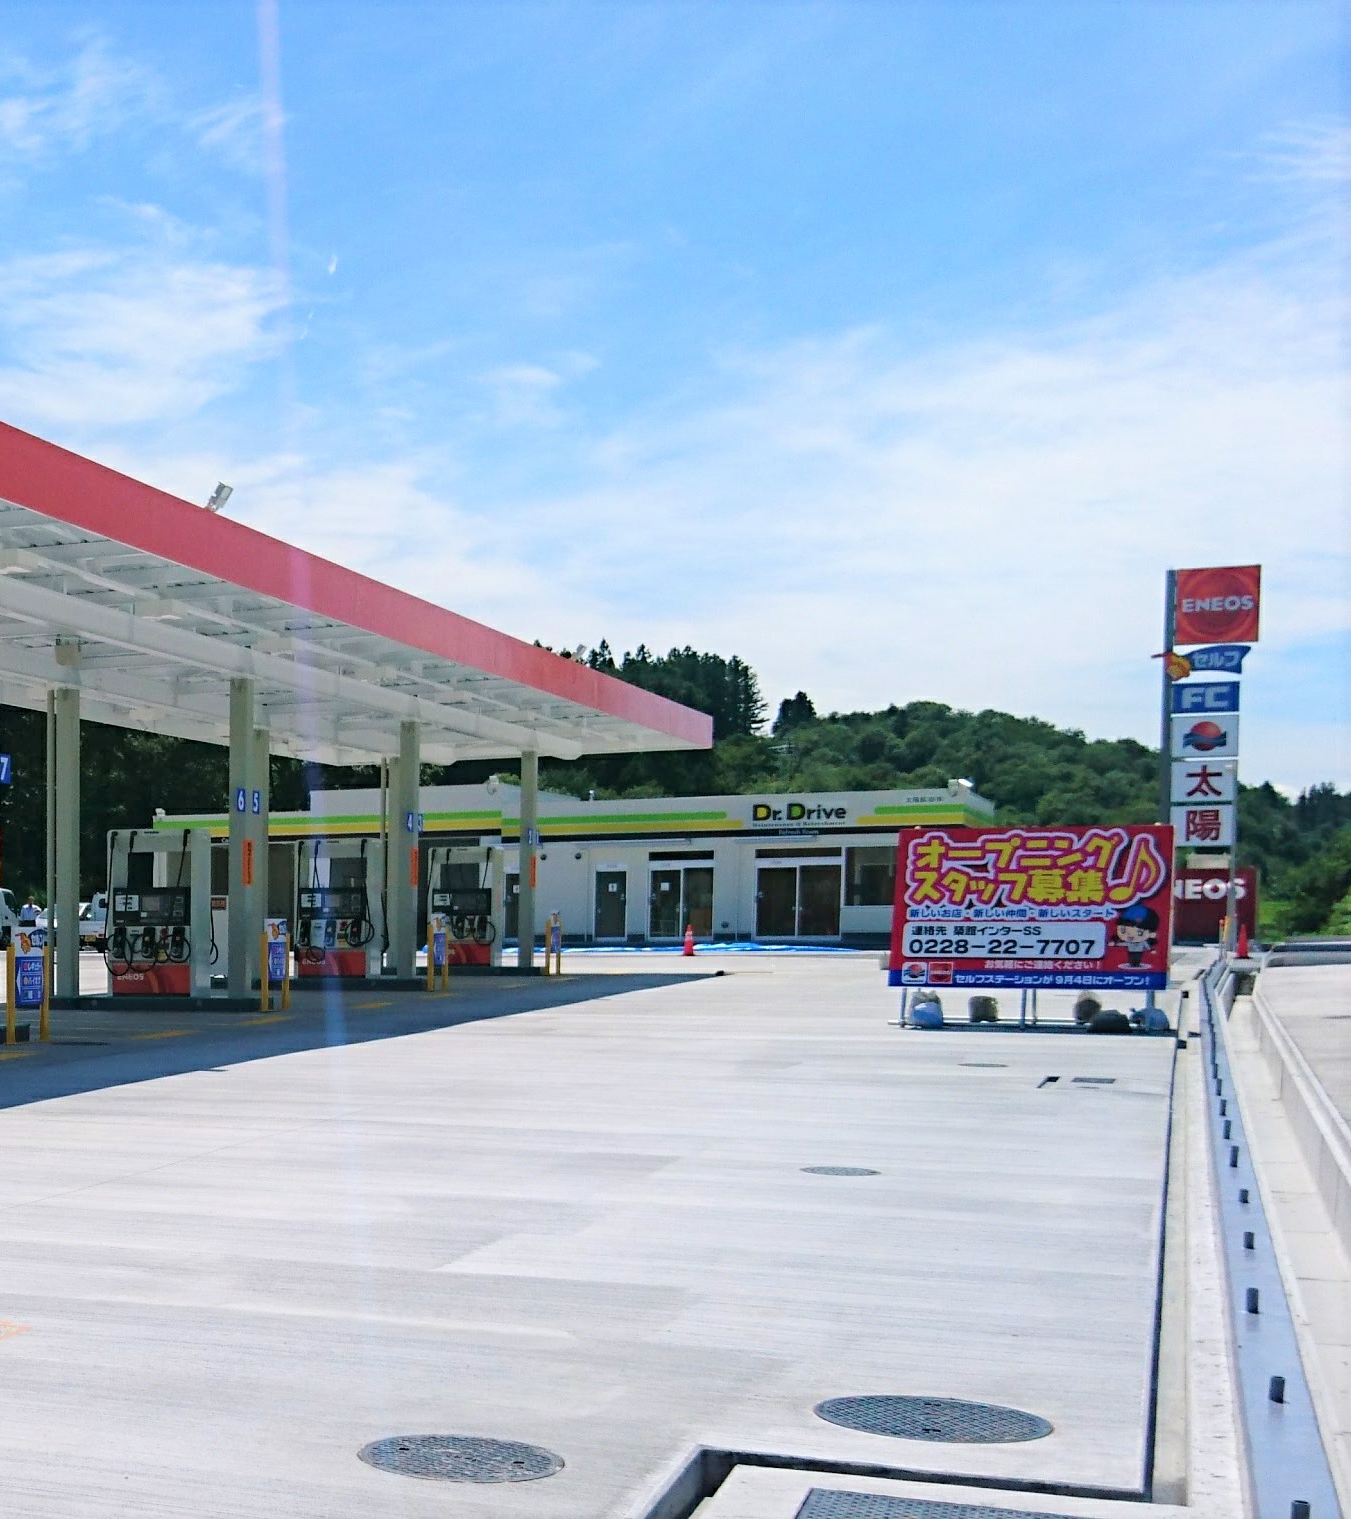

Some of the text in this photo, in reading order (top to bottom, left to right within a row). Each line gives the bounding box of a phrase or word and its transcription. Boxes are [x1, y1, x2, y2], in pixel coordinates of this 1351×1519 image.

[1181, 595, 1254, 613] ENEOS
[1191, 651, 1242, 669] セルフ
[1180, 685, 1230, 709] FC
[0, 756, 9, 781] 7
[238, 790, 245, 811] 6
[253, 792, 259, 812] 5
[1185, 765, 1223, 842] 太陽
[916, 836, 1120, 869] オープニング
[913, 869, 1104, 902] スタッフ募集
[911, 926, 947, 936] 連絡先
[909, 939, 1096, 955] 0228-22-7707
